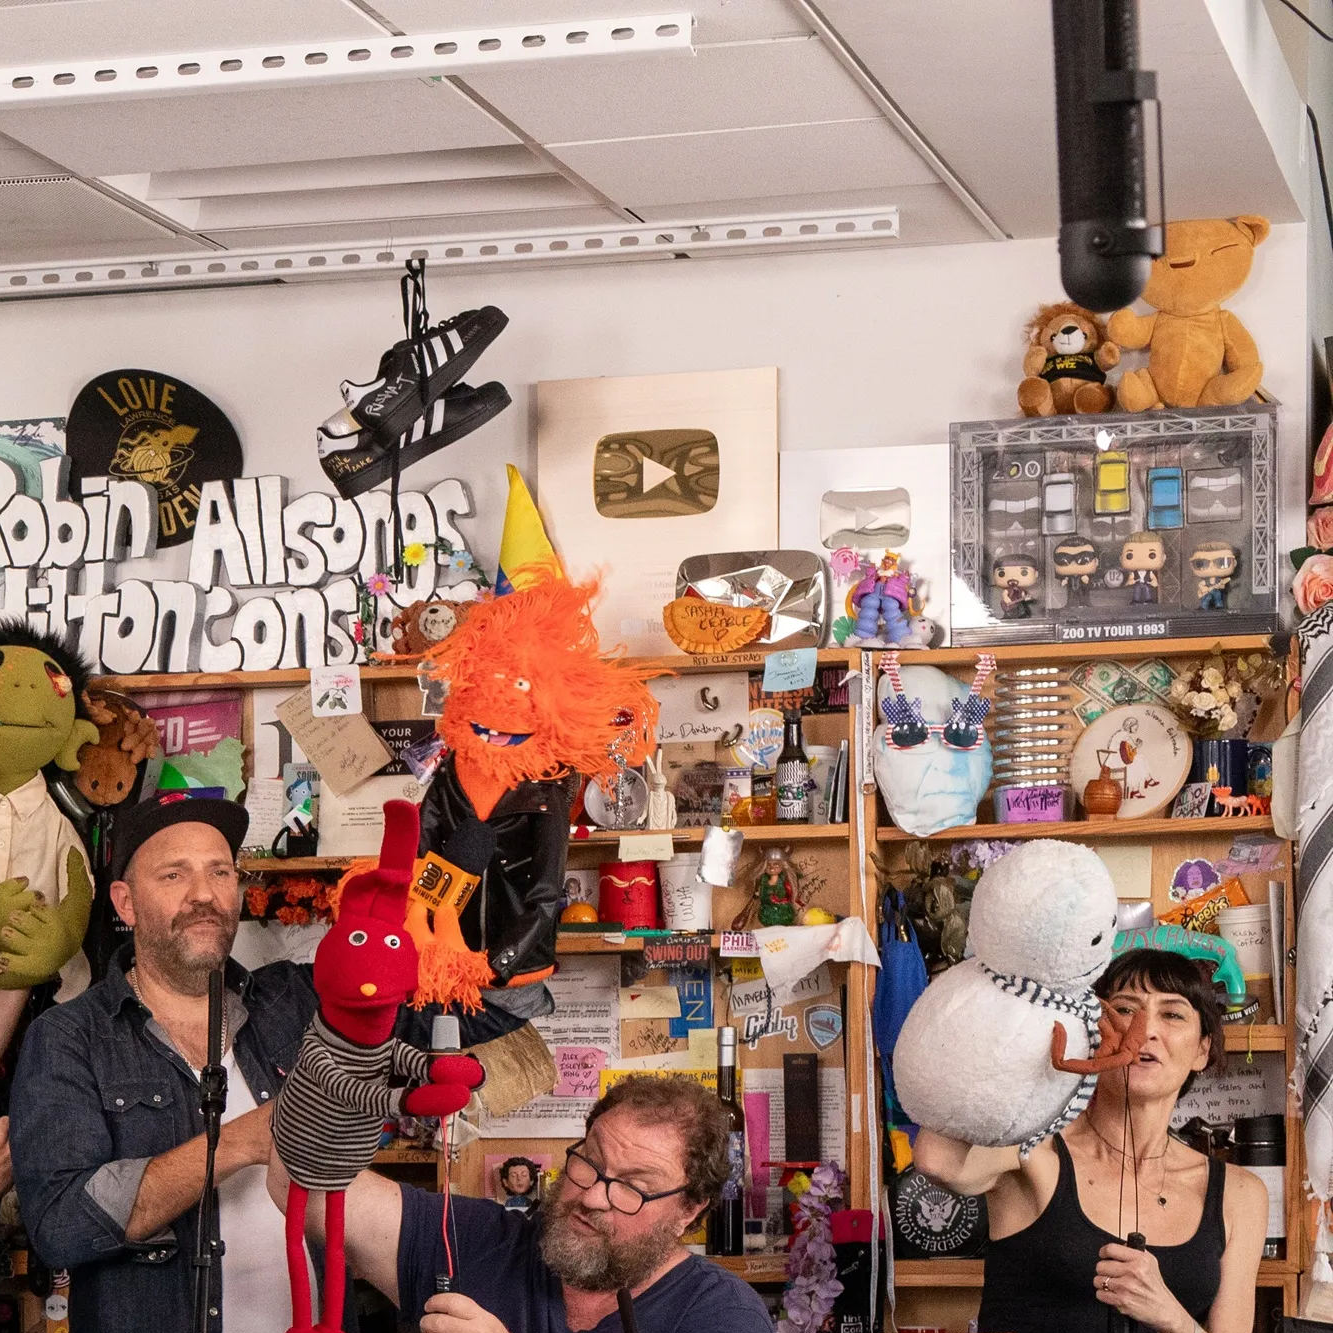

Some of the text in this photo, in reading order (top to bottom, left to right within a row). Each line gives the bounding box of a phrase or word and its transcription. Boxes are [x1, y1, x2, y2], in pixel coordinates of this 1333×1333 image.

[97, 377, 177, 417] LOVE
[1062, 623, 1165, 640] ZOO TV TOUR 1993
[693, 653, 762, 665] RED CLAY STRAYS
[381, 728, 412, 737] YOUR
[386, 764, 403, 773] MY
[413, 884, 442, 908] MINUTOS
[644, 945, 710, 961] SWING OUT
[735, 967, 758, 975] MIKE
[561, 1053, 578, 1061] ALEX
[1248, 1081, 1267, 1090] and
[1207, 1112, 1222, 1122] the
[895, 1193, 913, 1242] TOMMY
